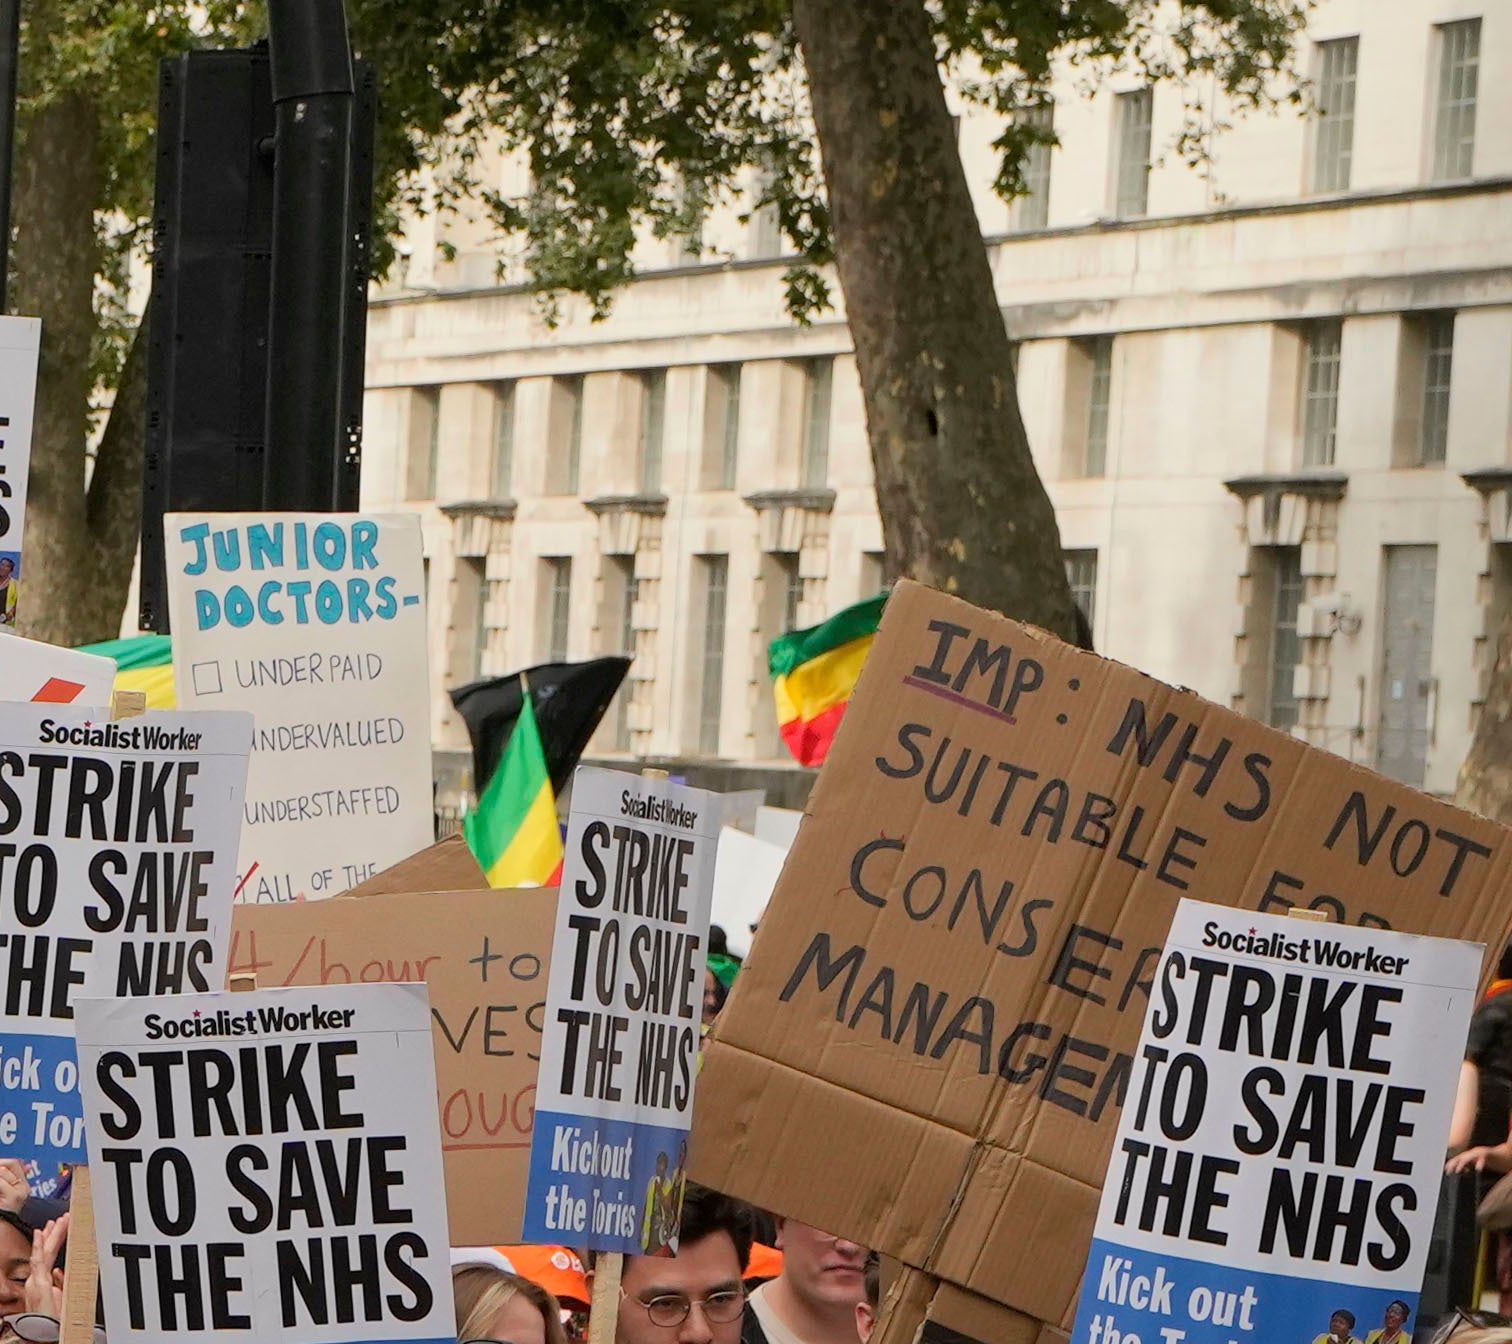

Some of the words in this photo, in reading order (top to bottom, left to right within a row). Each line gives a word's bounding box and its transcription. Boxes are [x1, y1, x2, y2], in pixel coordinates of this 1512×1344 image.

[180, 520, 379, 575] JUNIOR
[244, 785, 400, 826] UNDERSTAFFED
[875, 724, 1208, 891] SUITABLE
[1108, 699, 1272, 823] NHS
[1324, 791, 1491, 898] NOT
[83, 849, 214, 933] SAVE
[258, 873, 298, 902] ALL
[310, 868, 337, 892] OF
[575, 820, 695, 925] STRIKE
[116, 939, 214, 997] NHS
[470, 936, 541, 983] to
[568, 915, 620, 1007] TO
[625, 923, 700, 1019] SAVE
[557, 1008, 629, 1102] THE
[634, 1020, 694, 1113] NHS
[1151, 950, 1404, 1076] STRIKE
[96, 1040, 365, 1141] STRIKE
[1132, 1044, 1209, 1143] TO
[1232, 1065, 1426, 1176] SAVE
[102, 1146, 196, 1236] TO
[225, 1136, 414, 1235] SAVE
[550, 1124, 600, 1179] Kick
[600, 1134, 633, 1181] out
[544, 1184, 586, 1235] the
[590, 1188, 636, 1239] Tories
[1113, 1138, 1240, 1247] THE
[1258, 1167, 1418, 1272] NHS
[111, 1243, 252, 1332] THE
[276, 1232, 433, 1329] NHS
[1097, 1254, 1178, 1316] Kick
[1188, 1284, 1258, 1332] out
